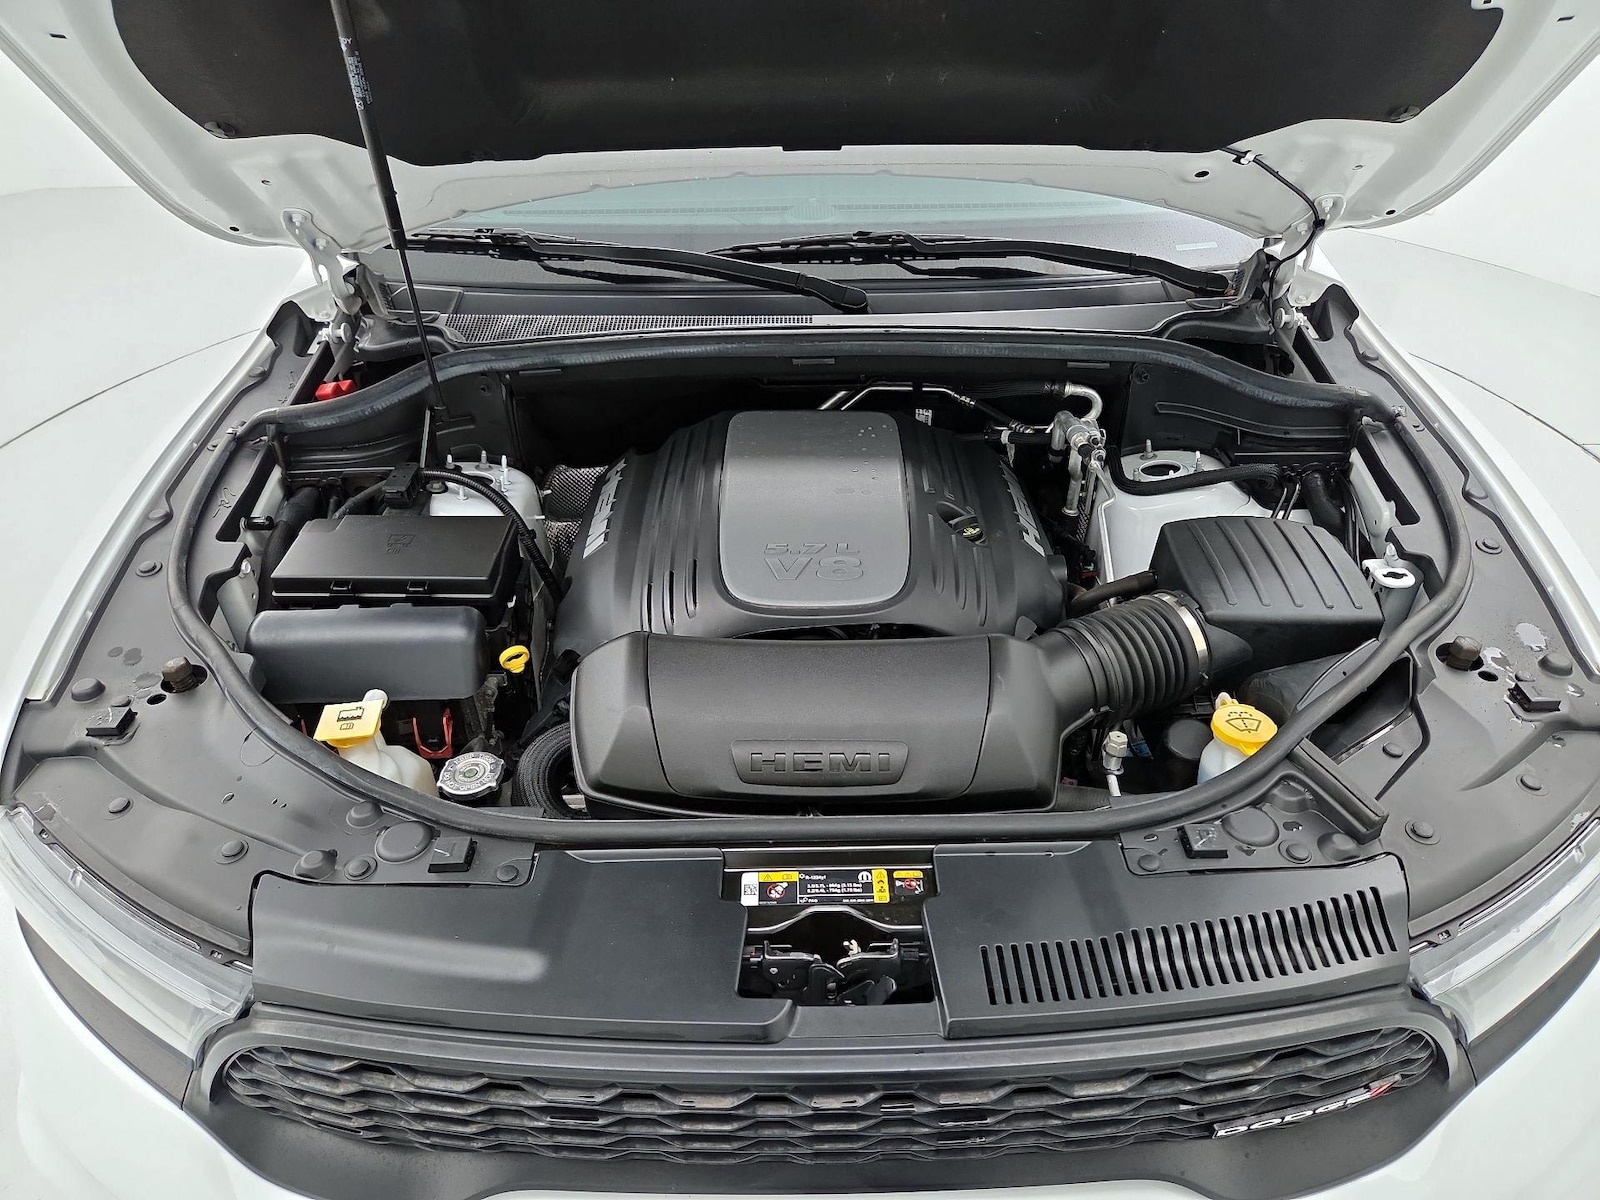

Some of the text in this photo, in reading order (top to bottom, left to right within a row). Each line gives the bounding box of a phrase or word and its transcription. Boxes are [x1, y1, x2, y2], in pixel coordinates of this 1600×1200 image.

[764, 557, 863, 581] V8
[750, 752, 891, 773] HEMI
[1214, 1094, 1371, 1137] DODGE
